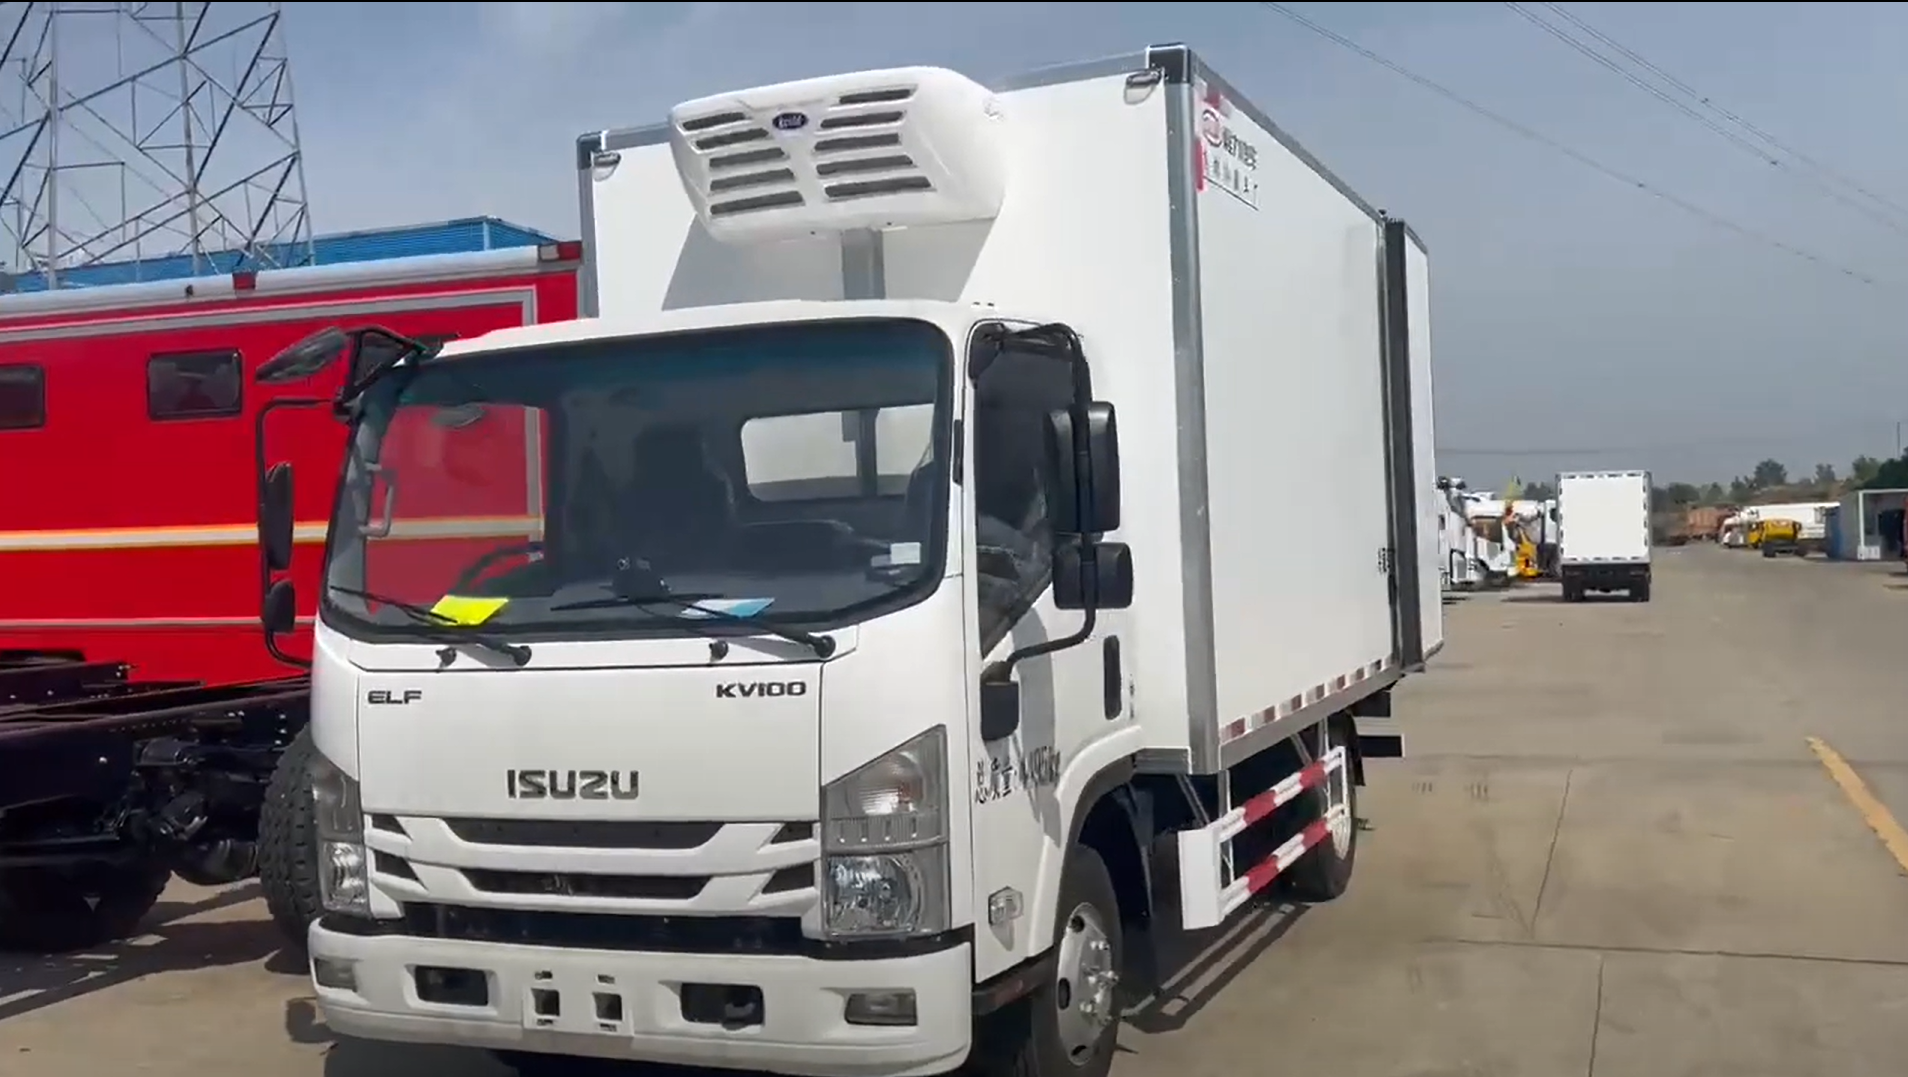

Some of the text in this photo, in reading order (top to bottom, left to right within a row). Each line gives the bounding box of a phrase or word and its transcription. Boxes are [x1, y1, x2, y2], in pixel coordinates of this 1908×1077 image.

[367, 690, 422, 705] ELF
[715, 681, 807, 699] KV100
[507, 769, 640, 800] ISUZU
